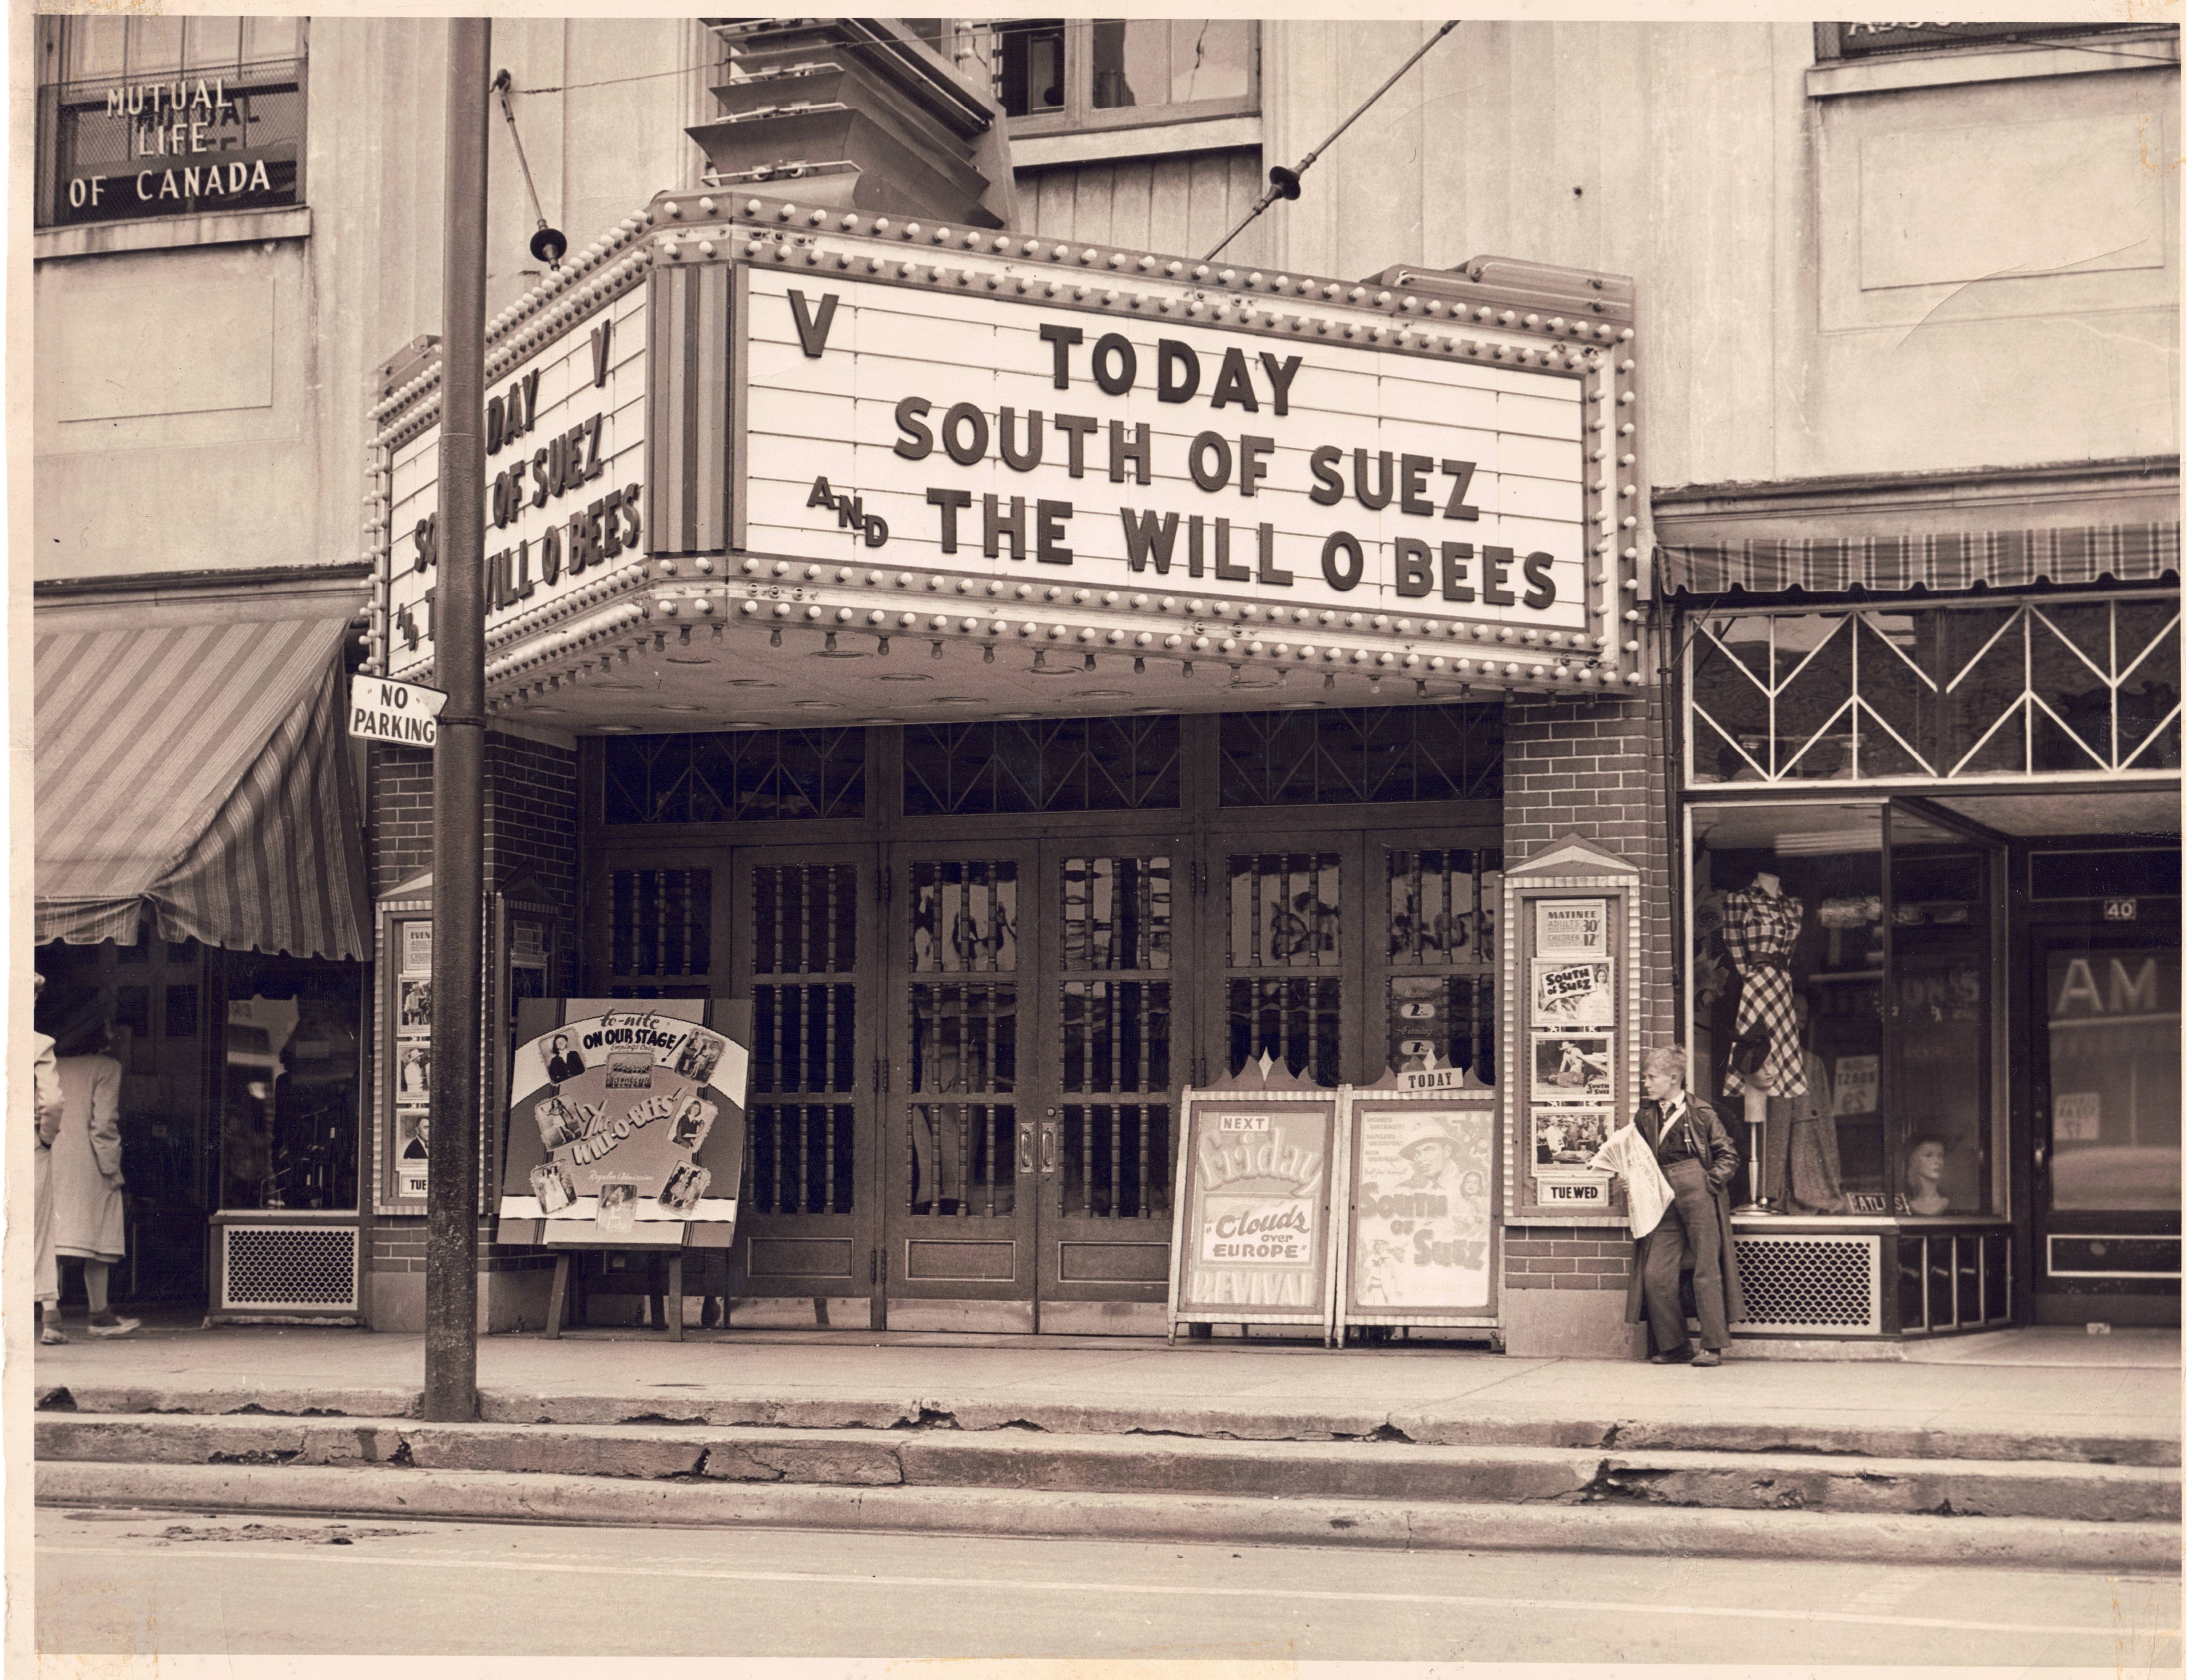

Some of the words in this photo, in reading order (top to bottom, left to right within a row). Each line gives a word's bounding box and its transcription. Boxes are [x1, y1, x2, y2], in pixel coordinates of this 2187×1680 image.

[107, 78, 232, 118] MUTUAL
[139, 122, 208, 156] LIFE
[69, 175, 107, 207] OF
[136, 160, 270, 201] CANADA
[787, 289, 839, 359] V
[590, 319, 611, 388] V
[1039, 323, 1303, 417] TODAY
[487, 367, 540, 456] DAY
[493, 459, 524, 530] OF
[532, 412, 603, 508] SUEZ
[893, 396, 1151, 486] SOUTH
[1189, 431, 1275, 497] OF
[1309, 445, 1480, 522] SUEZ
[541, 524, 561, 586] O
[568, 482, 639, 575] BEES
[806, 476, 889, 548] AND
[926, 487, 1073, 566] THE
[1120, 507, 1293, 587] WILL
[1321, 531, 1364, 592] O
[1395, 537, 1556, 610] BEES
[380, 684, 408, 709] NO
[354, 708, 435, 743] PARKING
[1548, 910, 1597, 919] MATINEE
[2108, 903, 2133, 917] 40
[1546, 968, 1590, 986] SOUTH
[1559, 979, 1591, 994] SUEZ
[600, 1009, 660, 1030] to-nite
[1397, 1026, 1433, 1036] Evening
[583, 1030, 603, 1049] ON
[605, 1028, 633, 1045] OUR
[635, 1029, 687, 1063] STAGE!
[1408, 1072, 1452, 1089] TODAY
[1223, 1117, 1266, 1130] NEXT
[589, 1169, 616, 1183] Regular
[617, 1172, 653, 1181] Admission
[1198, 1127, 1323, 1197] Friday
[1359, 1182, 1448, 1219] SOUTH
[1261, 1232, 1293, 1243] over
[1413, 1228, 1487, 1271] SUEZ
